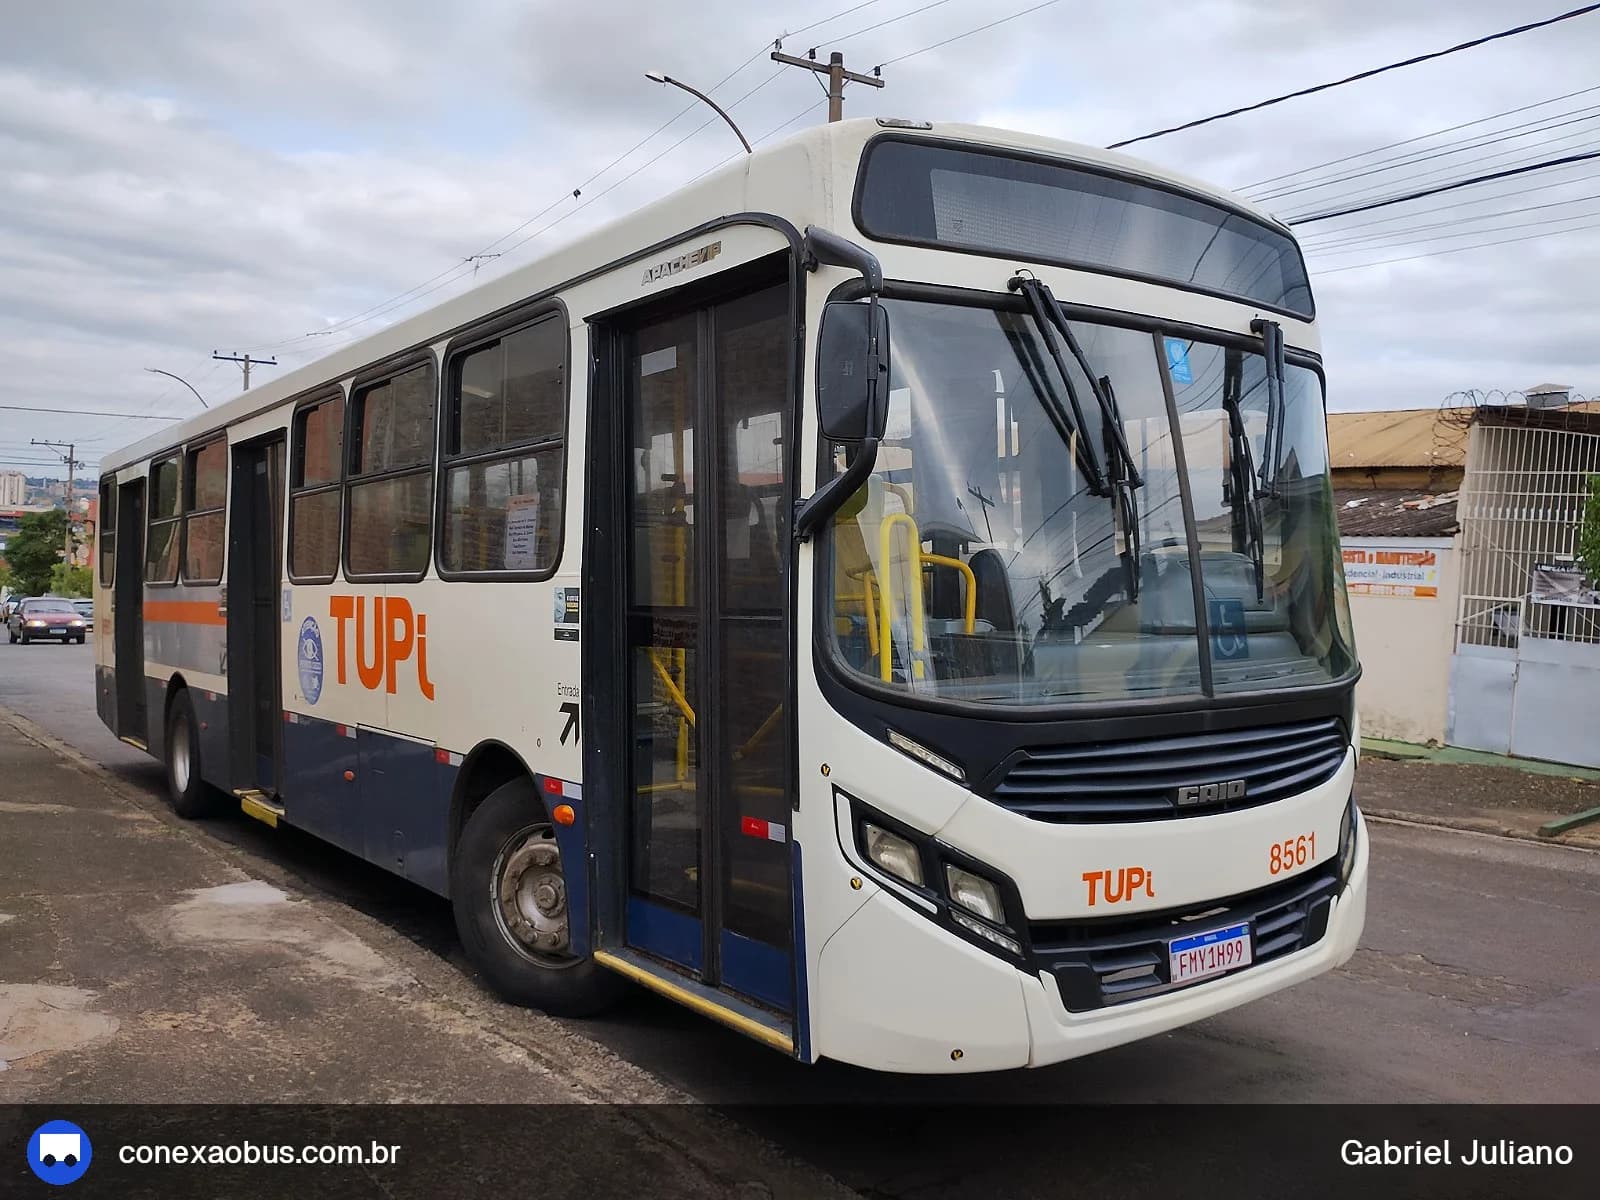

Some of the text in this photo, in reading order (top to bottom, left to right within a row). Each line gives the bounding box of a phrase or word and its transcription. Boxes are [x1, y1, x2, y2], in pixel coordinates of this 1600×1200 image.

[557, 682, 580, 698] Entrada
[1177, 779, 1246, 806] CAIO
[1269, 831, 1316, 875] 8561
[1179, 940, 1243, 977] FMY1H99
